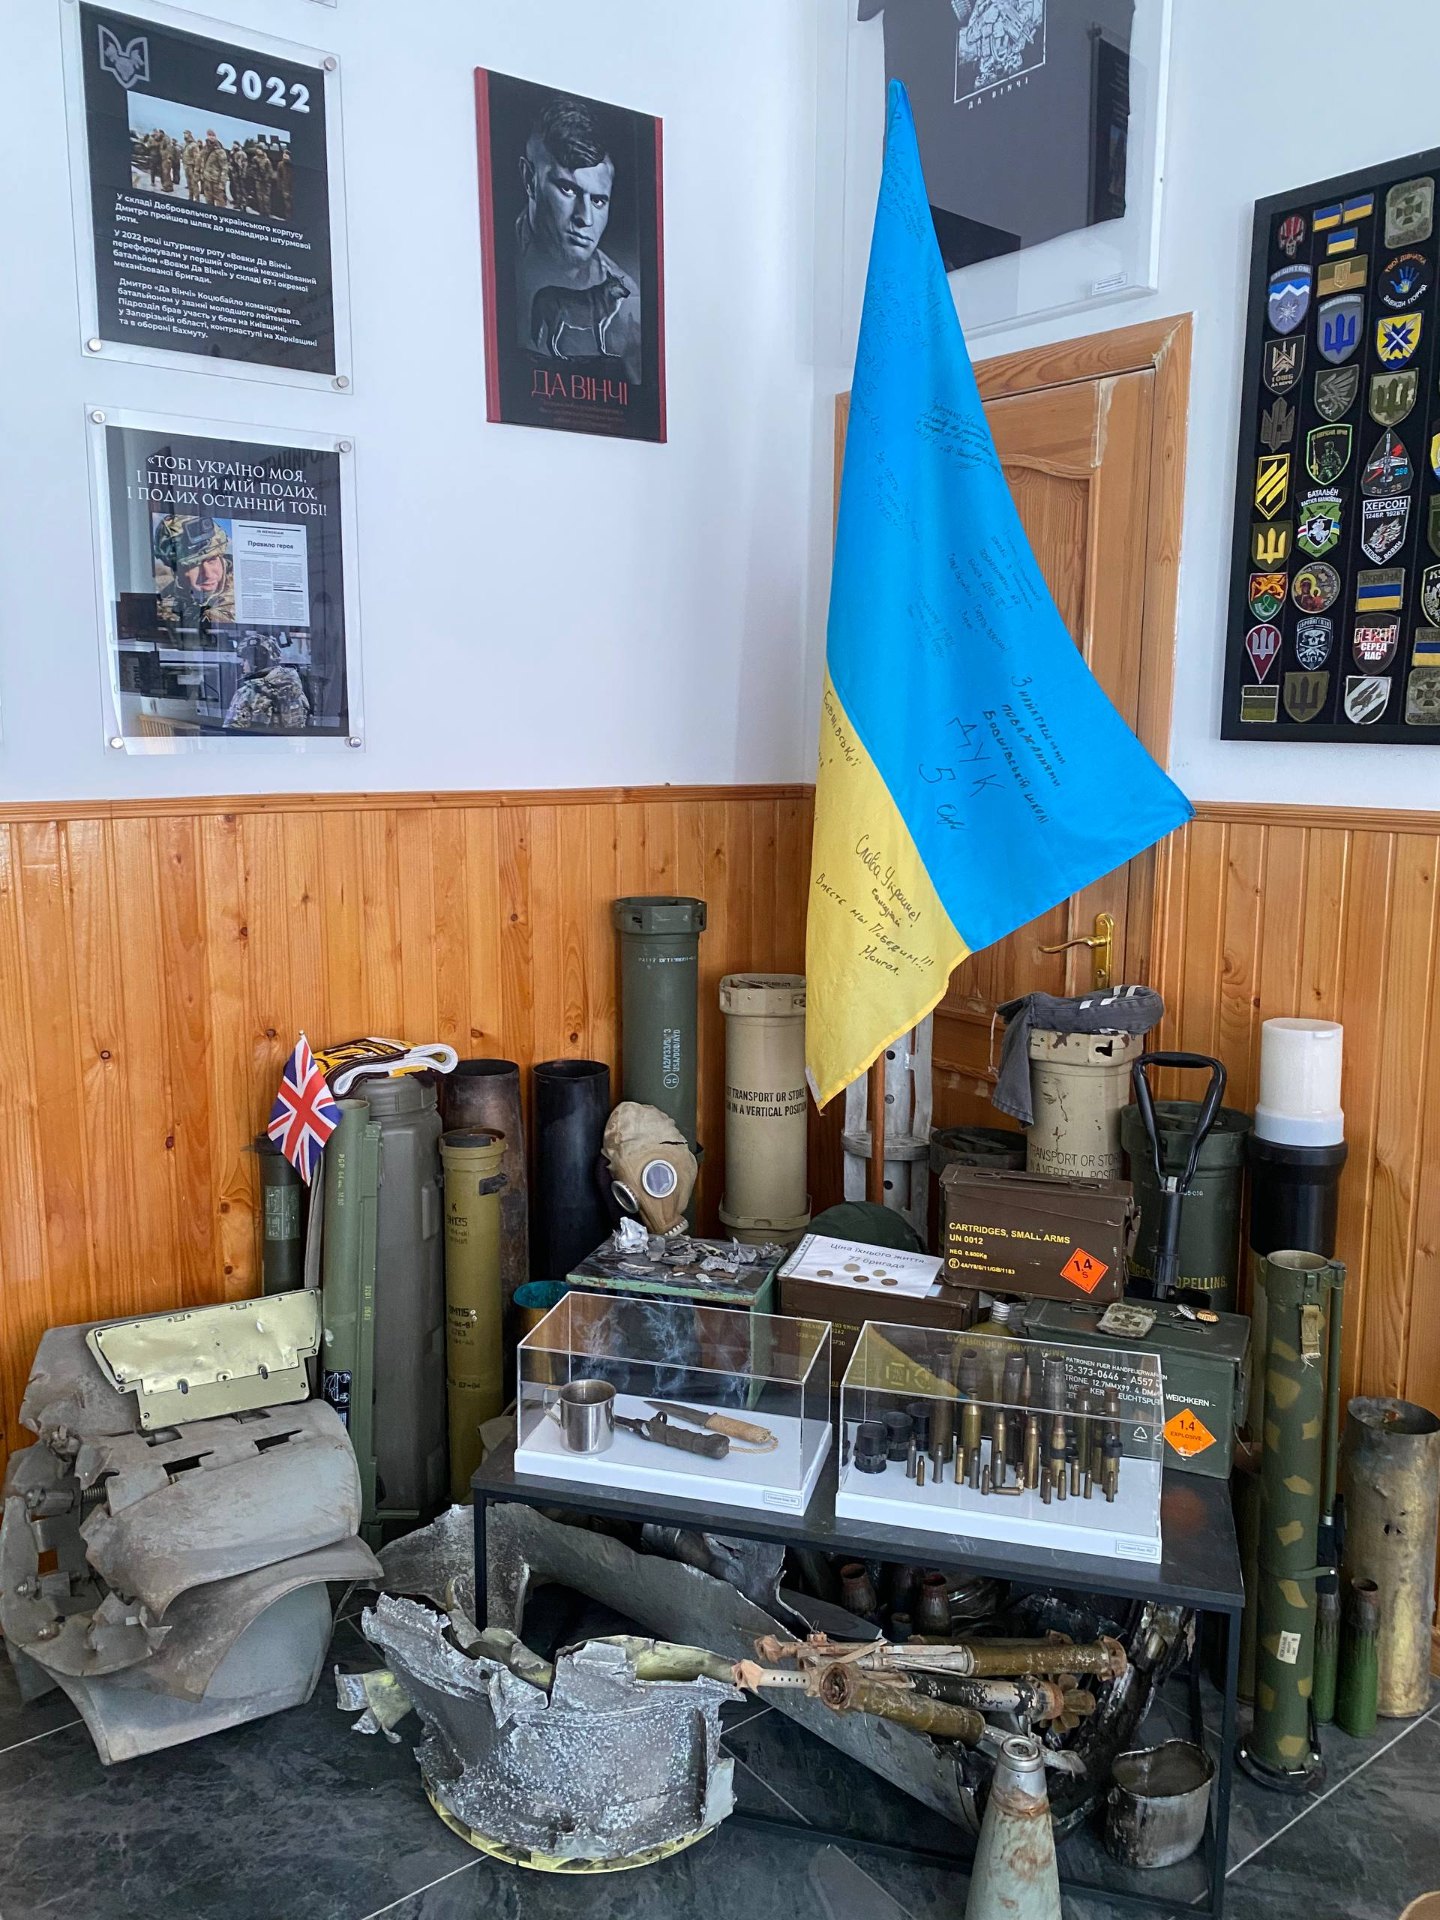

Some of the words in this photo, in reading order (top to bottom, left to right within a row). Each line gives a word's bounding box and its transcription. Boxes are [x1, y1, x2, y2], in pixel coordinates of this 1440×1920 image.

[216, 62, 311, 114] 2022
[115, 214, 139, 224] роти.
[115, 203, 149, 216] Дмитро
[150, 211, 189, 225] пройшов
[190, 219, 212, 229] шлях
[213, 224, 224, 232] до
[225, 227, 269, 241] командира
[270, 236, 311, 250] штурмової
[124, 195, 152, 207] складі
[154, 201, 218, 221] Добровольчого
[220, 216, 271, 232] українського
[272, 227, 303, 240] корпусу
[122, 231, 142, 241] 2022
[143, 236, 162, 245] році
[163, 240, 205, 255] штурмову
[206, 248, 225, 258] роту
[226, 252, 255, 263] «Вовки
[256, 258, 267, 266] Да
[268, 260, 292, 270] Вінчі»
[112, 240, 181, 259] переформували
[182, 253, 188, 261] у
[189, 254, 222, 267] перший
[223, 262, 259, 274] окремий
[260, 269, 317, 285] механізований
[113, 249, 158, 264] батальйон
[159, 259, 190, 270] «Вовки
[191, 264, 202, 273] Да
[204, 267, 228, 277] Вінчі»
[229, 272, 234, 280] у
[235, 272, 261, 284] складі
[277, 282, 309, 292] окремої
[113, 260, 174, 277] механізованої
[175, 270, 212, 284] бригади.
[119, 278, 152, 290] Дмитро
[154, 284, 170, 293] «Да
[171, 288, 196, 297] Вінчі»
[197, 291, 243, 306] Коцюбайло
[245, 301, 291, 315] командував
[117, 287, 173, 303] батальйоном
[181, 299, 208, 310] званні
[209, 304, 254, 318] молодшого
[256, 313, 302, 326] лейтенанта.
[118, 297, 160, 311] Підрозділ
[161, 305, 181, 315] брав
[183, 309, 210, 320] участь
[218, 315, 237, 324] боях
[238, 318, 248, 326] на
[249, 319, 287, 334] Київщині,
[125, 309, 175, 323] Запорізькій
[176, 318, 209, 330] області,
[210, 324, 262, 338] контрнаступі
[263, 332, 273, 340] на
[274, 333, 317, 347] Харківщині
[137, 321, 171, 332] обороні
[172, 325, 209, 339] Бахмуту.
[531, 368, 566, 399] ДА
[571, 374, 628, 406] ВІНЧІ
[147, 455, 192, 471] «ТОБІ
[196, 459, 265, 479] УКРАЇНО
[136, 470, 142, 483] І
[147, 471, 219, 491] ПЕРШИЙ
[224, 479, 254, 494] МІЙ
[127, 486, 132, 499] І
[138, 487, 199, 505] ПОДИХ
[202, 493, 286, 513] ОСТАННІЙ
[289, 501, 327, 516] ТОБІ!
[1365, 499, 1407, 511] ХЕРСОН
[247, 540, 276, 549] Правило
[1383, 540, 1402, 560] ВОВКИ
[1353, 624, 1397, 644] ГЕРОЇ
[1360, 643, 1387, 652] СЕРЕД
[1363, 651, 1382, 660] НАС
[1011, 675, 1033, 687] З
[855, 834, 881, 879] Слава
[732, 1087, 774, 1103] TRANSPORT
[776, 1092, 787, 1103] OR
[739, 1104, 745, 1115] A
[745, 1105, 783, 1117] VERTICAL
[1080, 1154, 1096, 1167] OR
[949, 1222, 1009, 1238] CARTRIDGES,
[1011, 1230, 1042, 1241] SMALL
[1043, 1234, 1071, 1244] ARMS
[949, 1234, 962, 1242] UN
[963, 1236, 984, 1245] 0012
[830, 1243, 852, 1252] Ціна
[855, 1246, 892, 1259] їхнього
[893, 1254, 925, 1264] життя
[862, 1258, 905, 1269] бригада
[1073, 1258, 1093, 1272] 1.4
[1081, 1271, 1089, 1279] S
[1174, 1276, 1227, 1290] OPELLING.
[1065, 1356, 1095, 1368] PATRONEN
[1130, 1375, 1153, 1387] A557
[1165, 1393, 1210, 1407] WEICHKERN
[1179, 1419, 1195, 1432] 1.4
[1170, 1431, 1203, 1442] EXPLOSIVE
